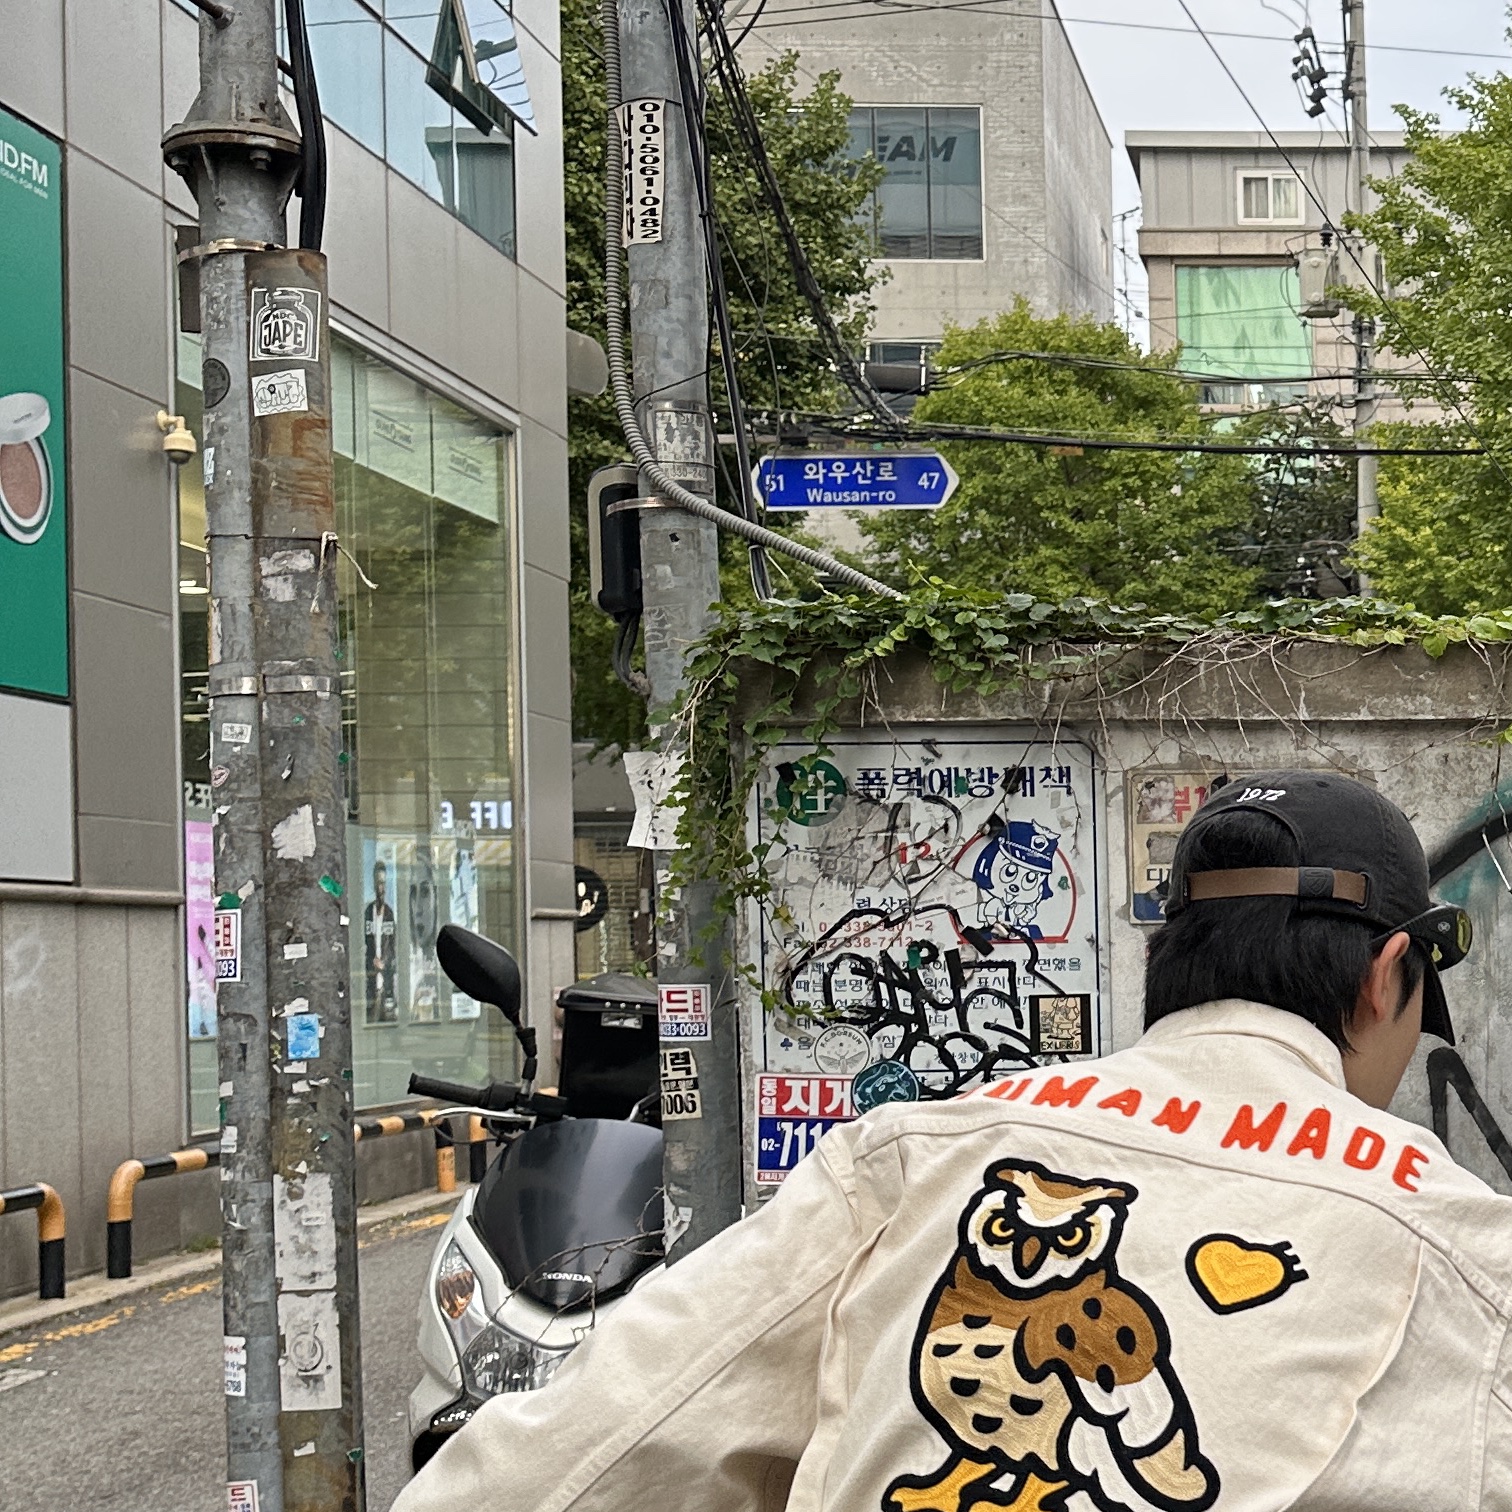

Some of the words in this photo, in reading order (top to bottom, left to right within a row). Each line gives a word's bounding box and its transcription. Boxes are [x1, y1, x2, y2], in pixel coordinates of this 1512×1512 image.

[264, 320, 304, 347] JAPE
[804, 460, 898, 485] 와우산로
[918, 472, 940, 490] 47
[807, 488, 896, 503] Wausan-ro
[958, 1076, 1201, 1134] UMAN
[1220, 1101, 1430, 1193] MADE
[542, 1272, 594, 1284] HONDA
